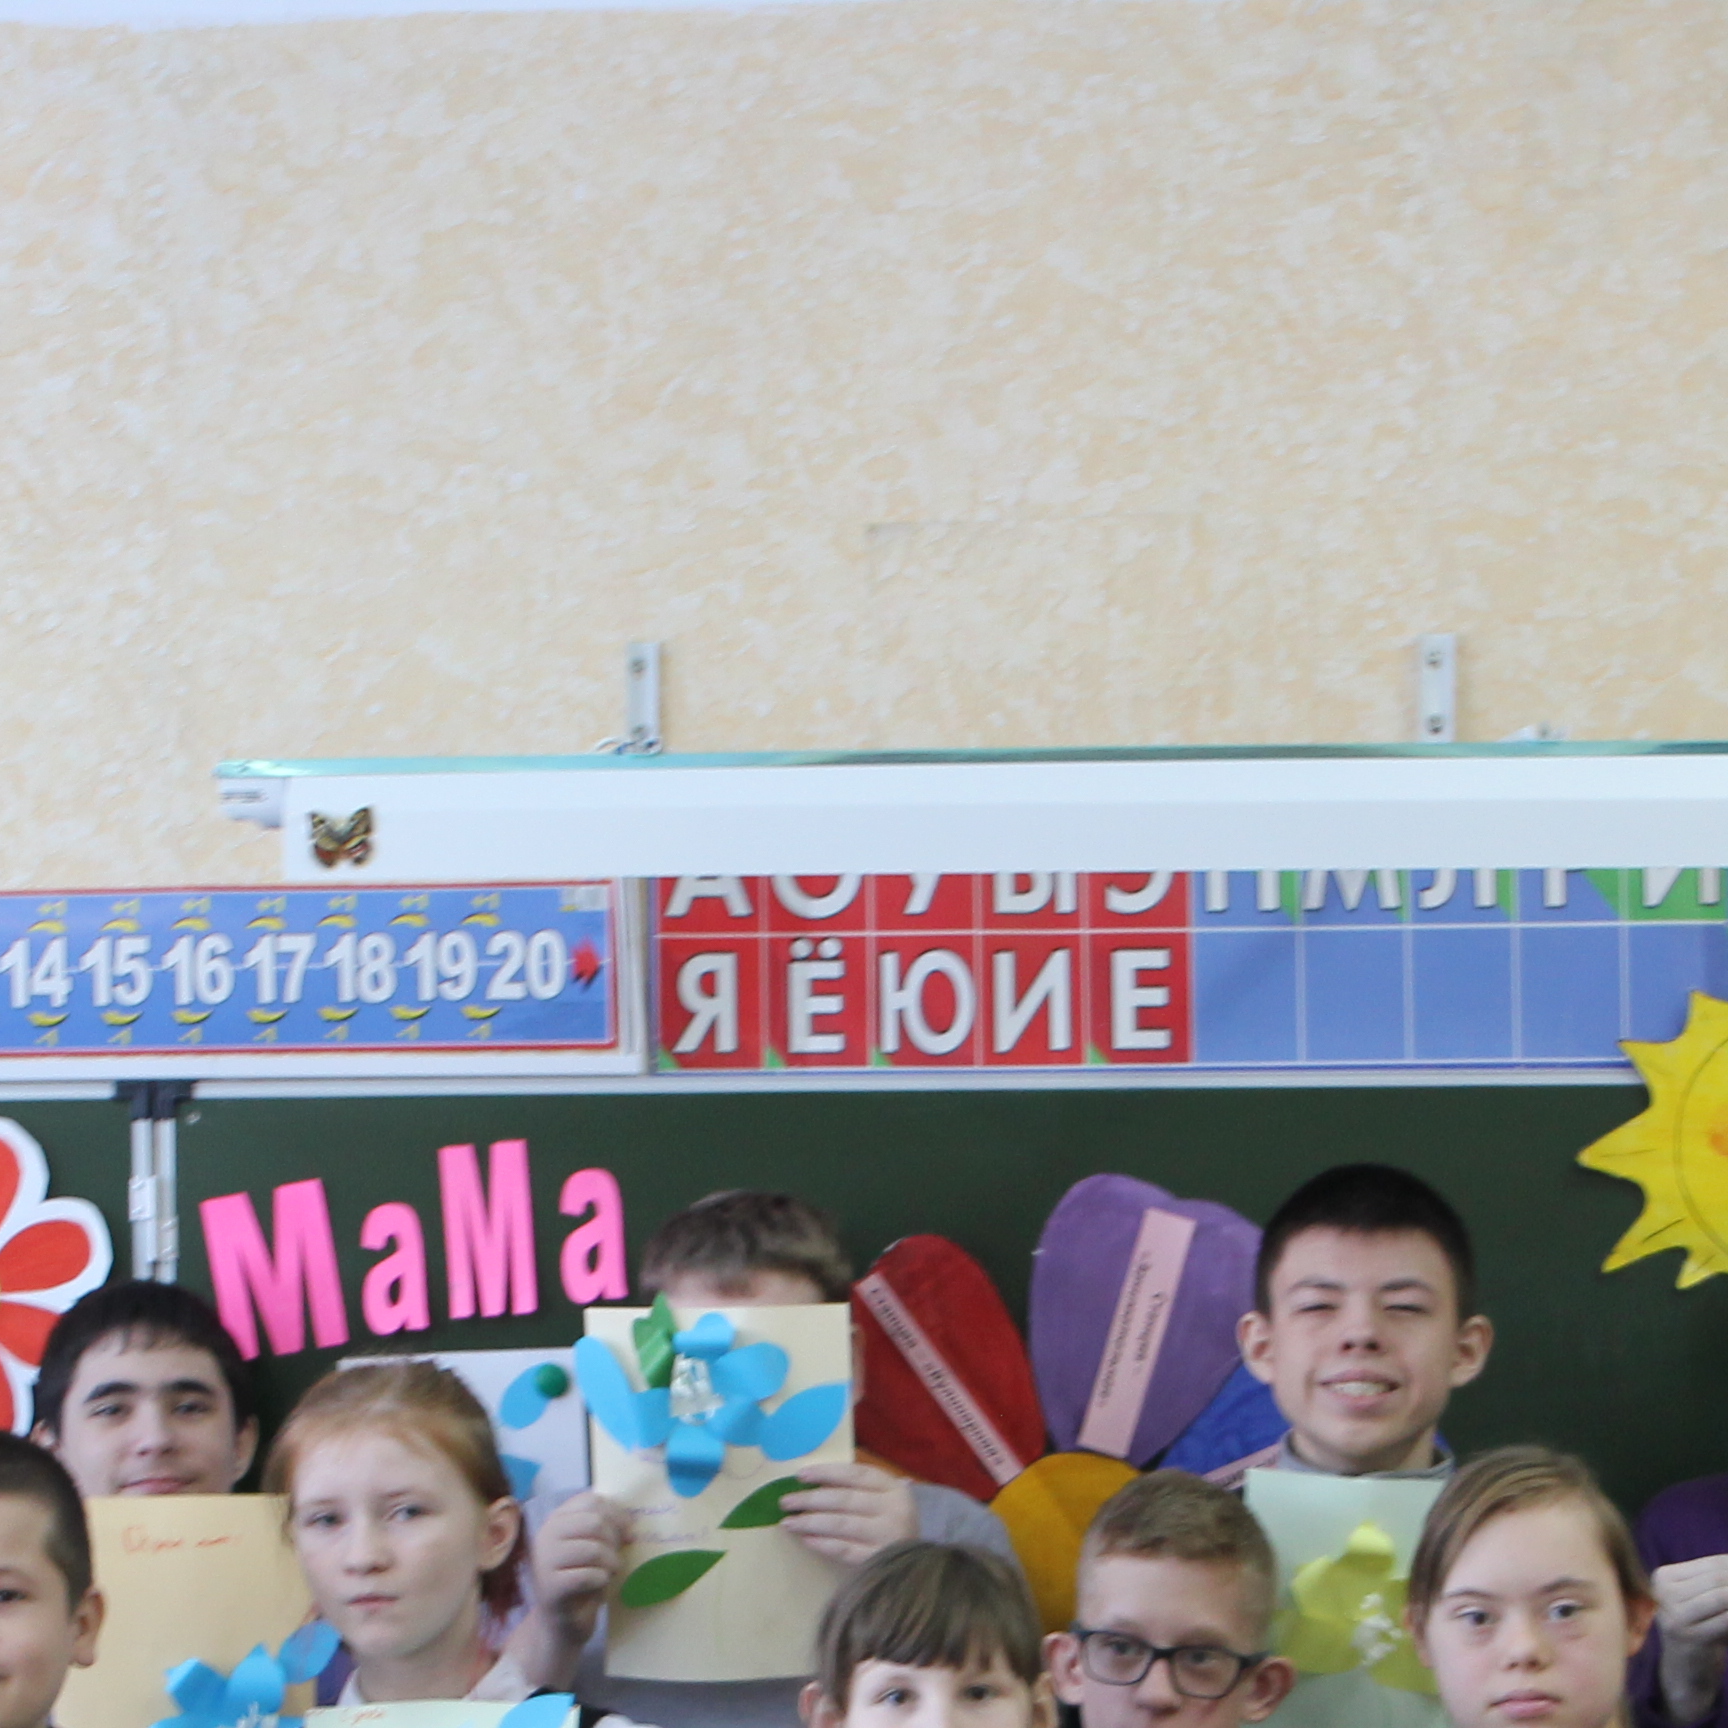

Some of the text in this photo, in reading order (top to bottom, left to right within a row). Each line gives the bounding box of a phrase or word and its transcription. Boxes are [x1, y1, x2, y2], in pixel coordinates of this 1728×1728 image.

[81, 936, 152, 1006] 15
[162, 934, 235, 1005] 16
[244, 934, 316, 1003] 17
[325, 932, 396, 1002] 18
[405, 931, 476, 1000] 19
[487, 930, 567, 1000] 20
